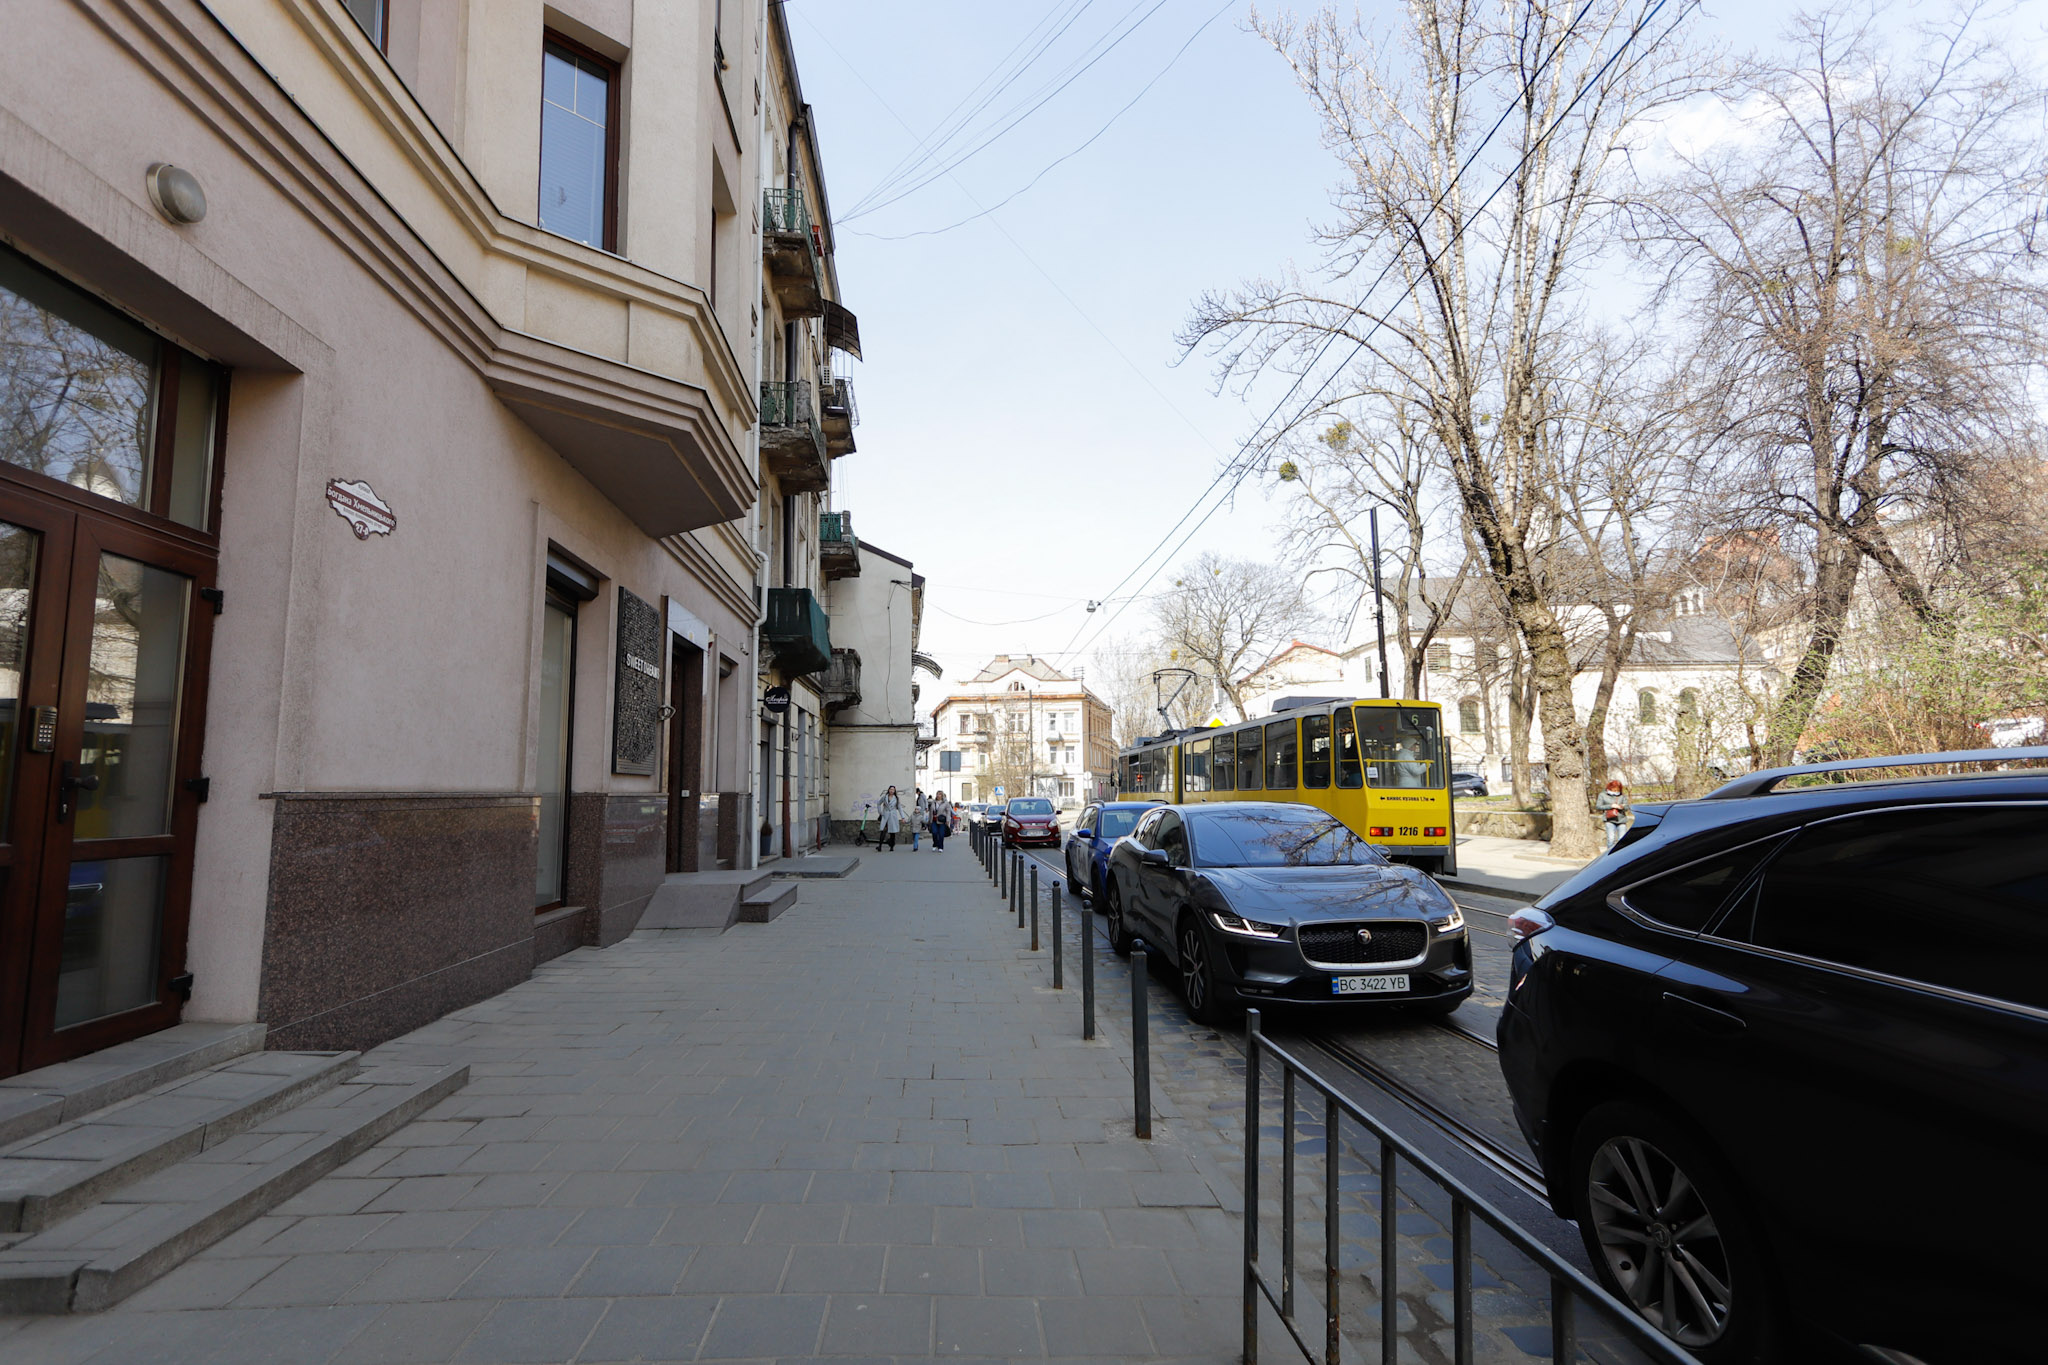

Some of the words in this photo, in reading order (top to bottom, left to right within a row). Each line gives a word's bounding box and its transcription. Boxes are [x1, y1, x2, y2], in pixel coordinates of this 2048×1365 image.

[327, 486, 352, 506] Богдана
[353, 499, 396, 527] Хмельницького
[626, 653, 644, 672] SWEET
[1411, 714, 1419, 726] 6
[1398, 826, 1419, 836] 1216
[1339, 979, 1356, 991] BC
[1360, 978, 1387, 990] 3422
[1389, 976, 1406, 989] YB
